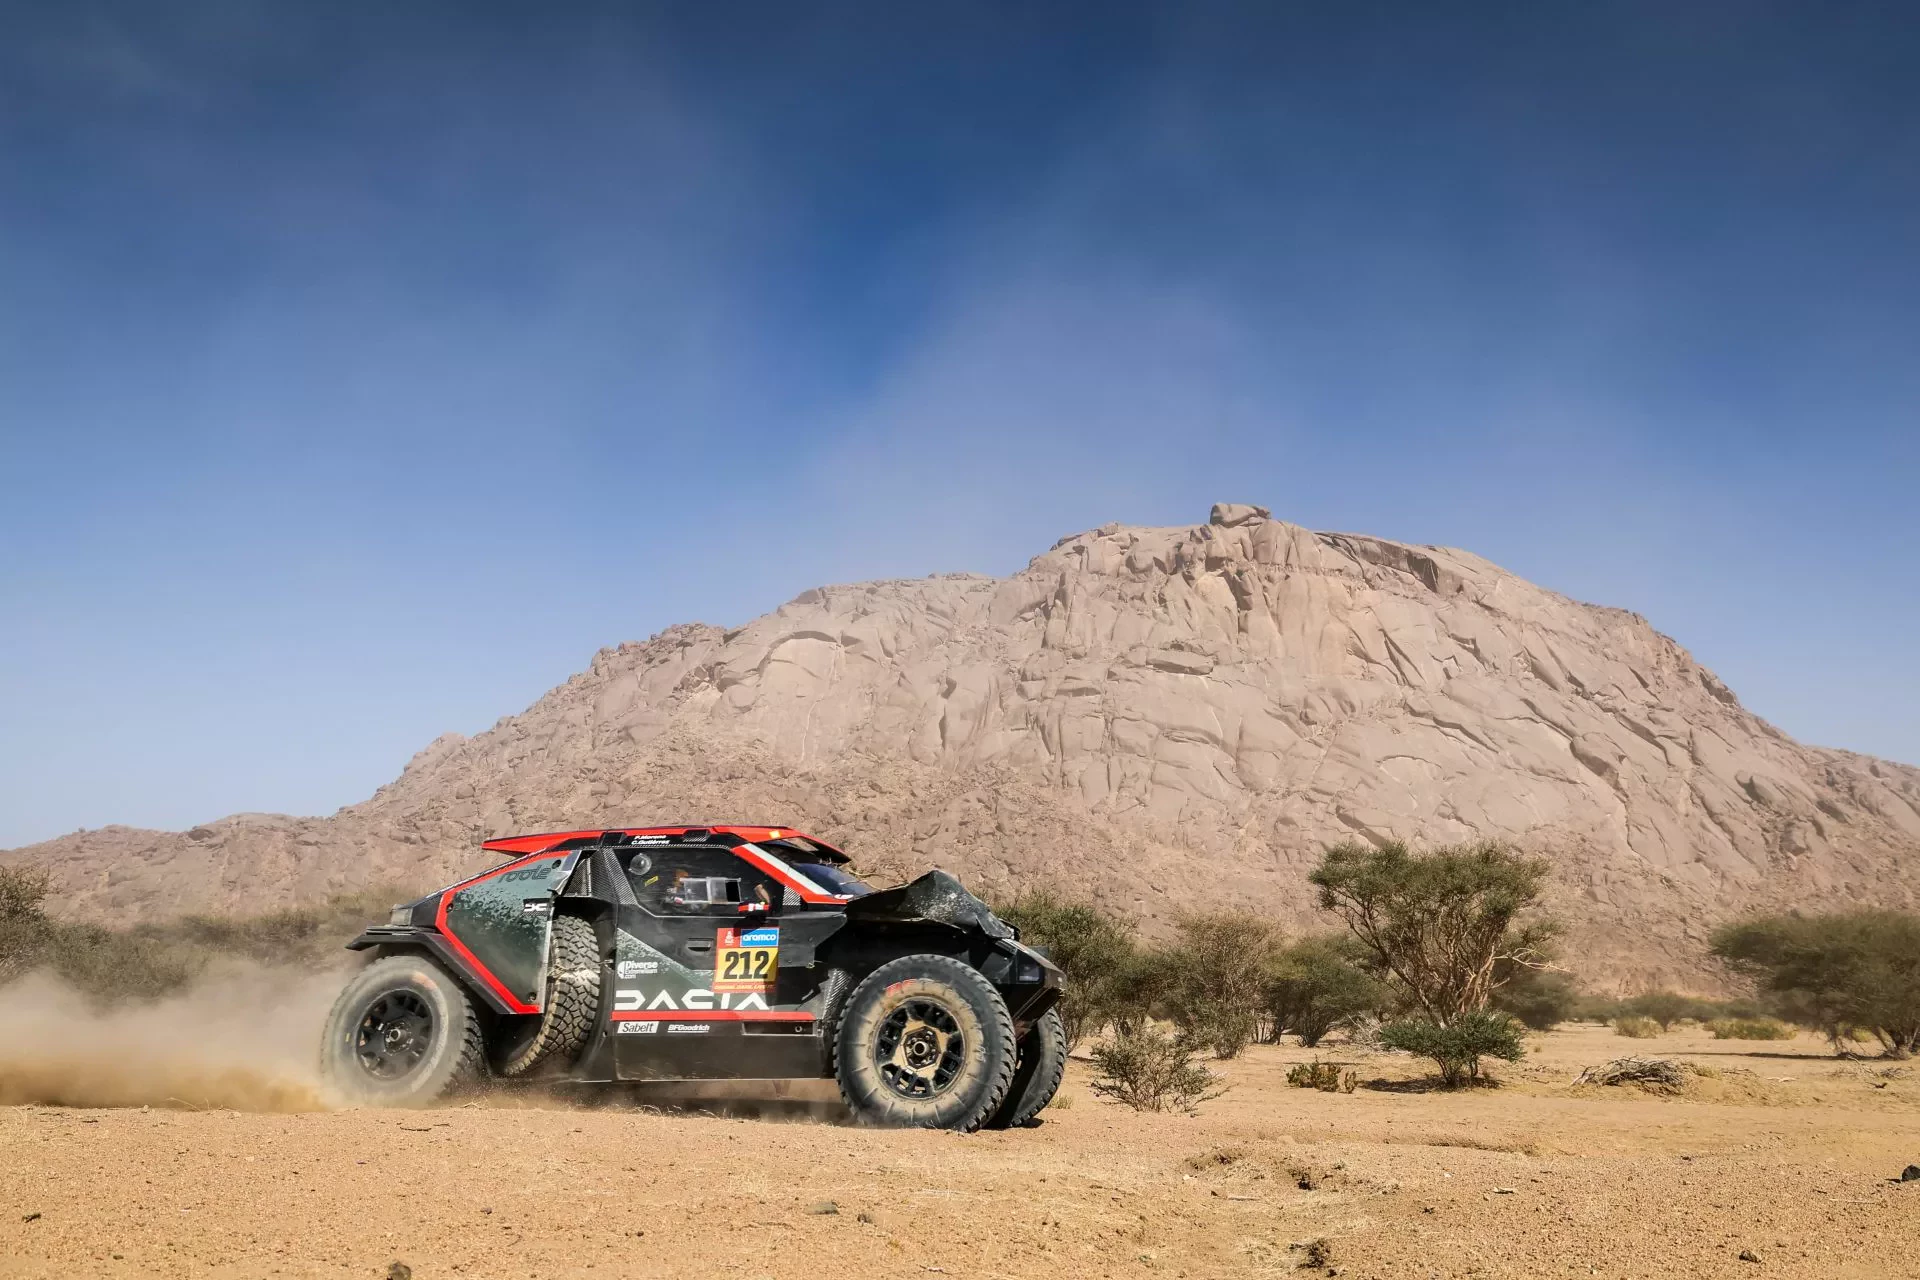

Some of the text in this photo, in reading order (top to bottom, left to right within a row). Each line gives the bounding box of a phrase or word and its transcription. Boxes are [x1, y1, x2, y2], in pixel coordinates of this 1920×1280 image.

[625, 960, 658, 970] Diverse
[723, 950, 770, 980] 212
[614, 989, 770, 1011] DACIA
[622, 1022, 654, 1033] Sabelt
[667, 1023, 711, 1031] BFGoodrich
